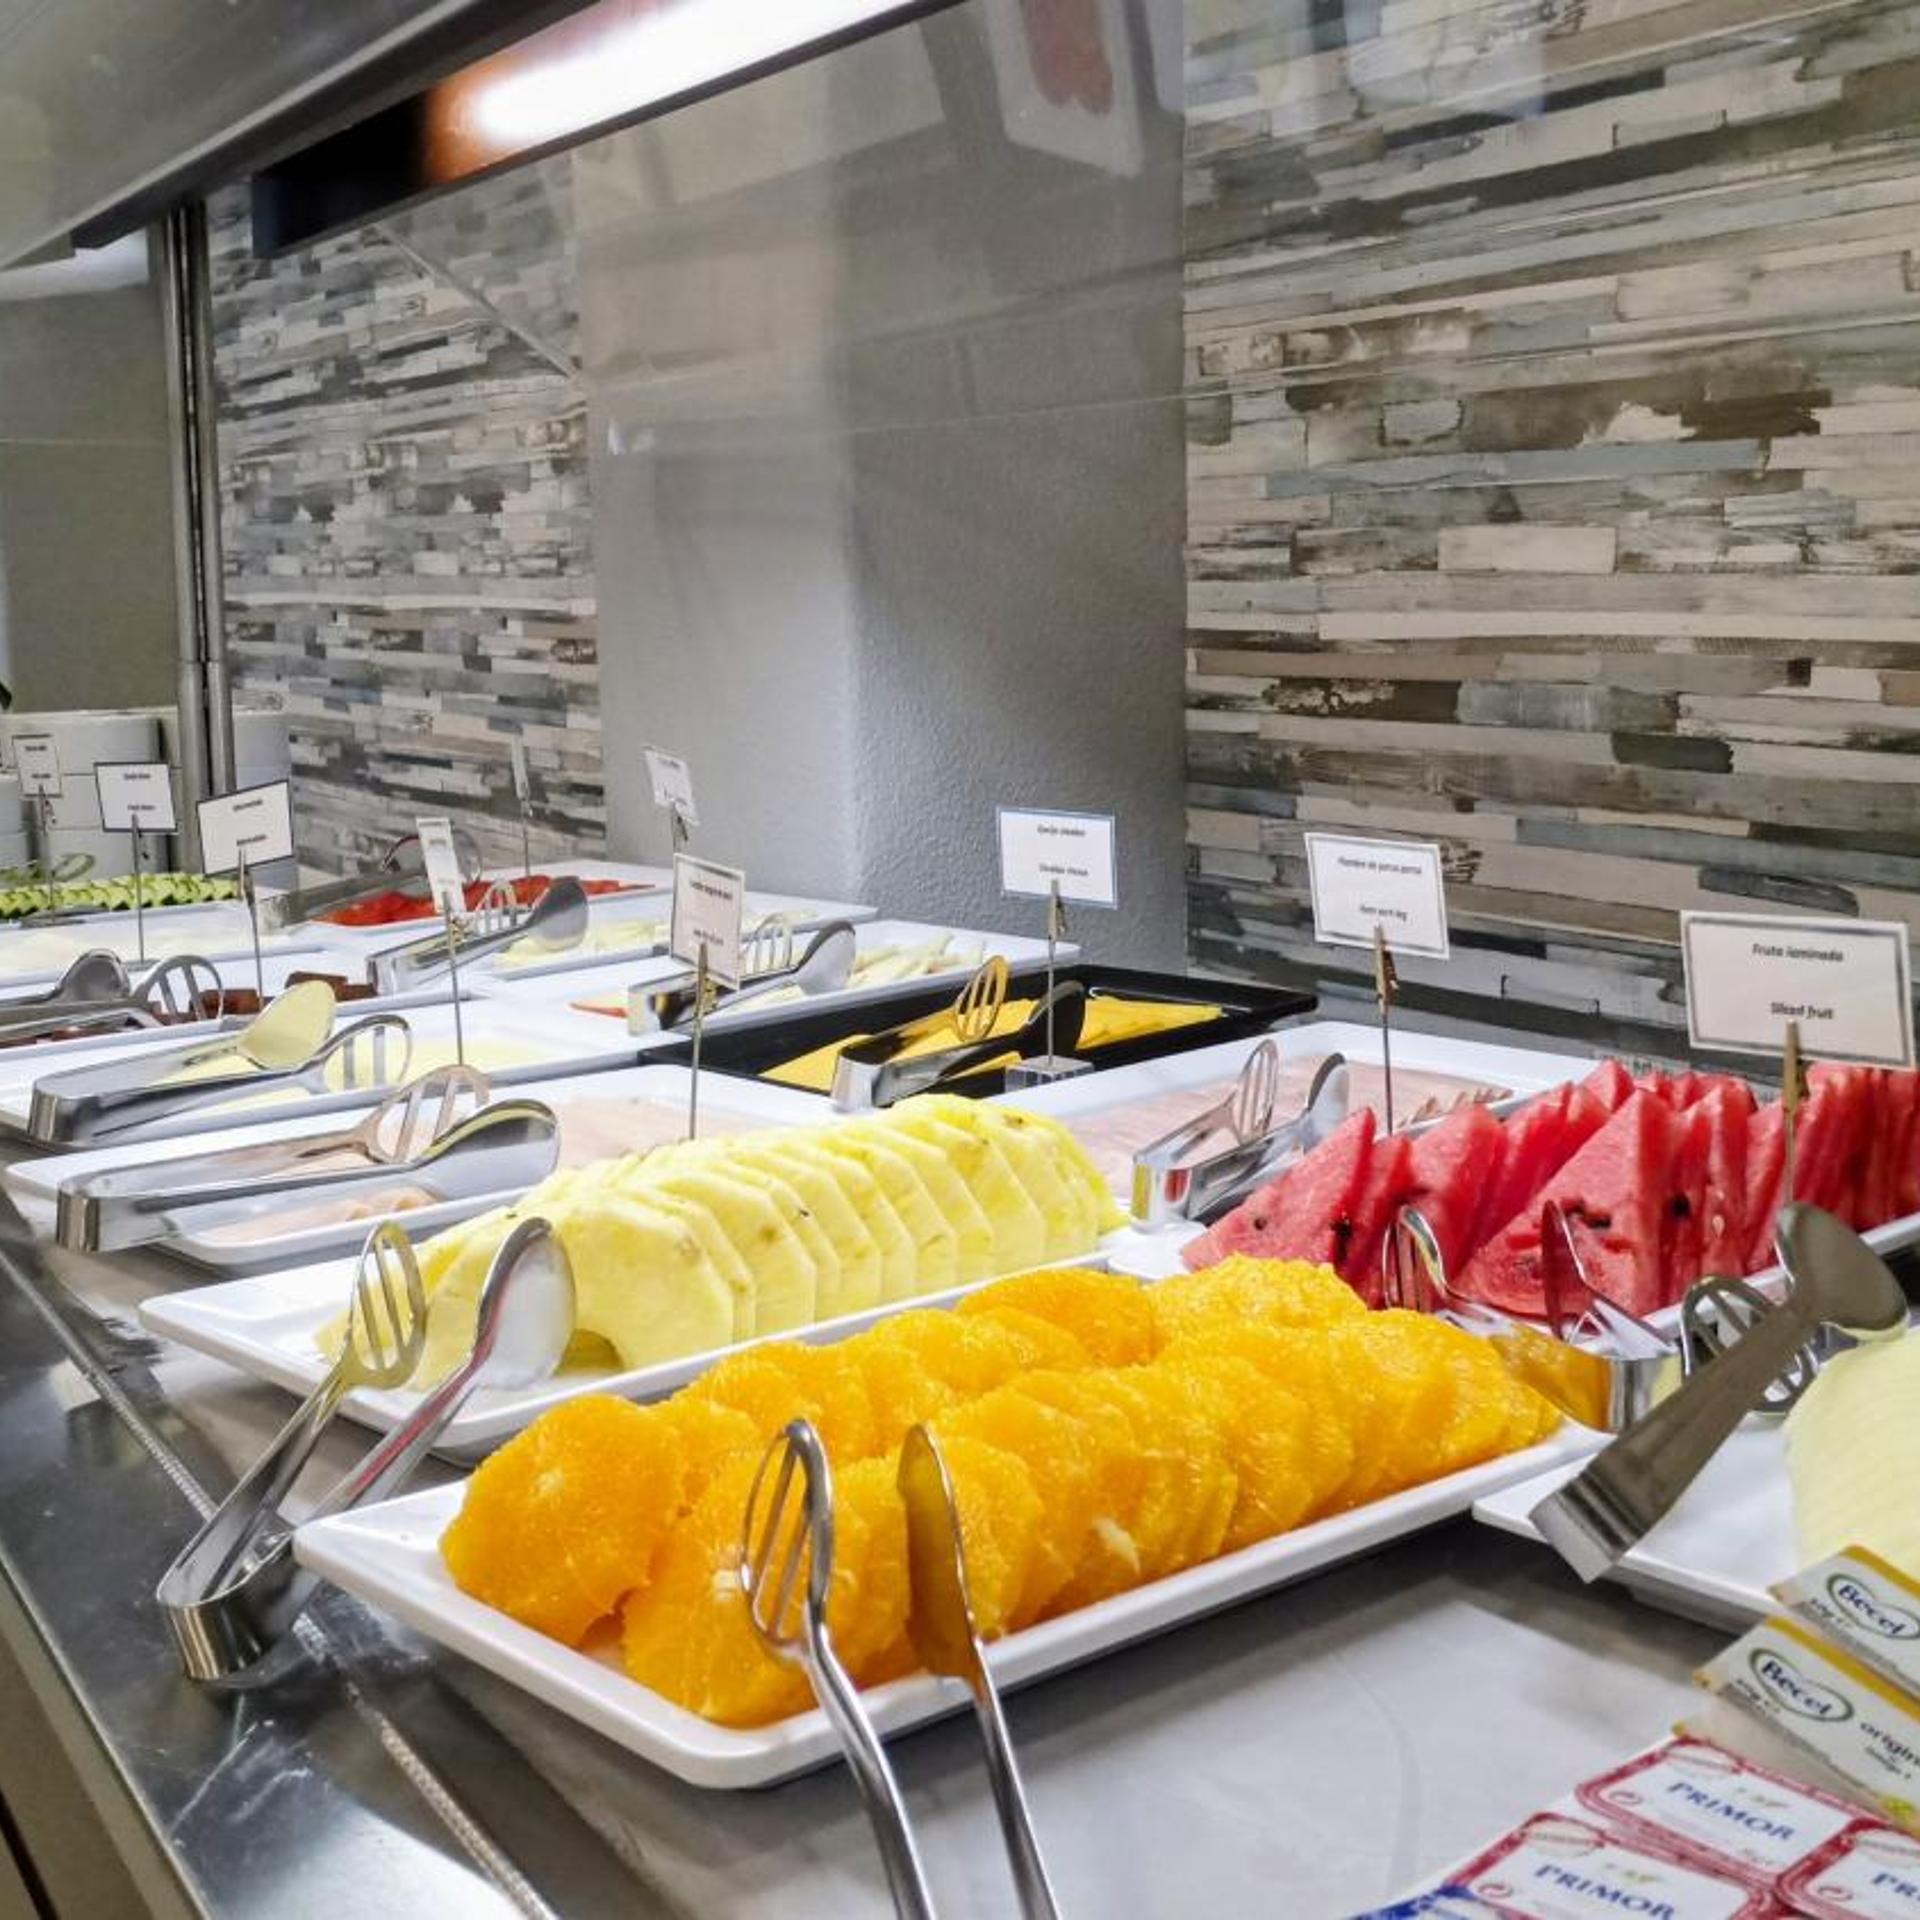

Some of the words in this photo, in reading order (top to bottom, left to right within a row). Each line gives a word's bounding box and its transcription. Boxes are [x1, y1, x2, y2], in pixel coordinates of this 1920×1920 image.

[1805, 1004, 1834, 1020] fruit
[1837, 1584, 1906, 1635] Becel
[1761, 1659, 1833, 1716] Becel
[1667, 1781, 1797, 1841] PRIMOR
[1534, 1863, 1676, 1920] PRIMOR
